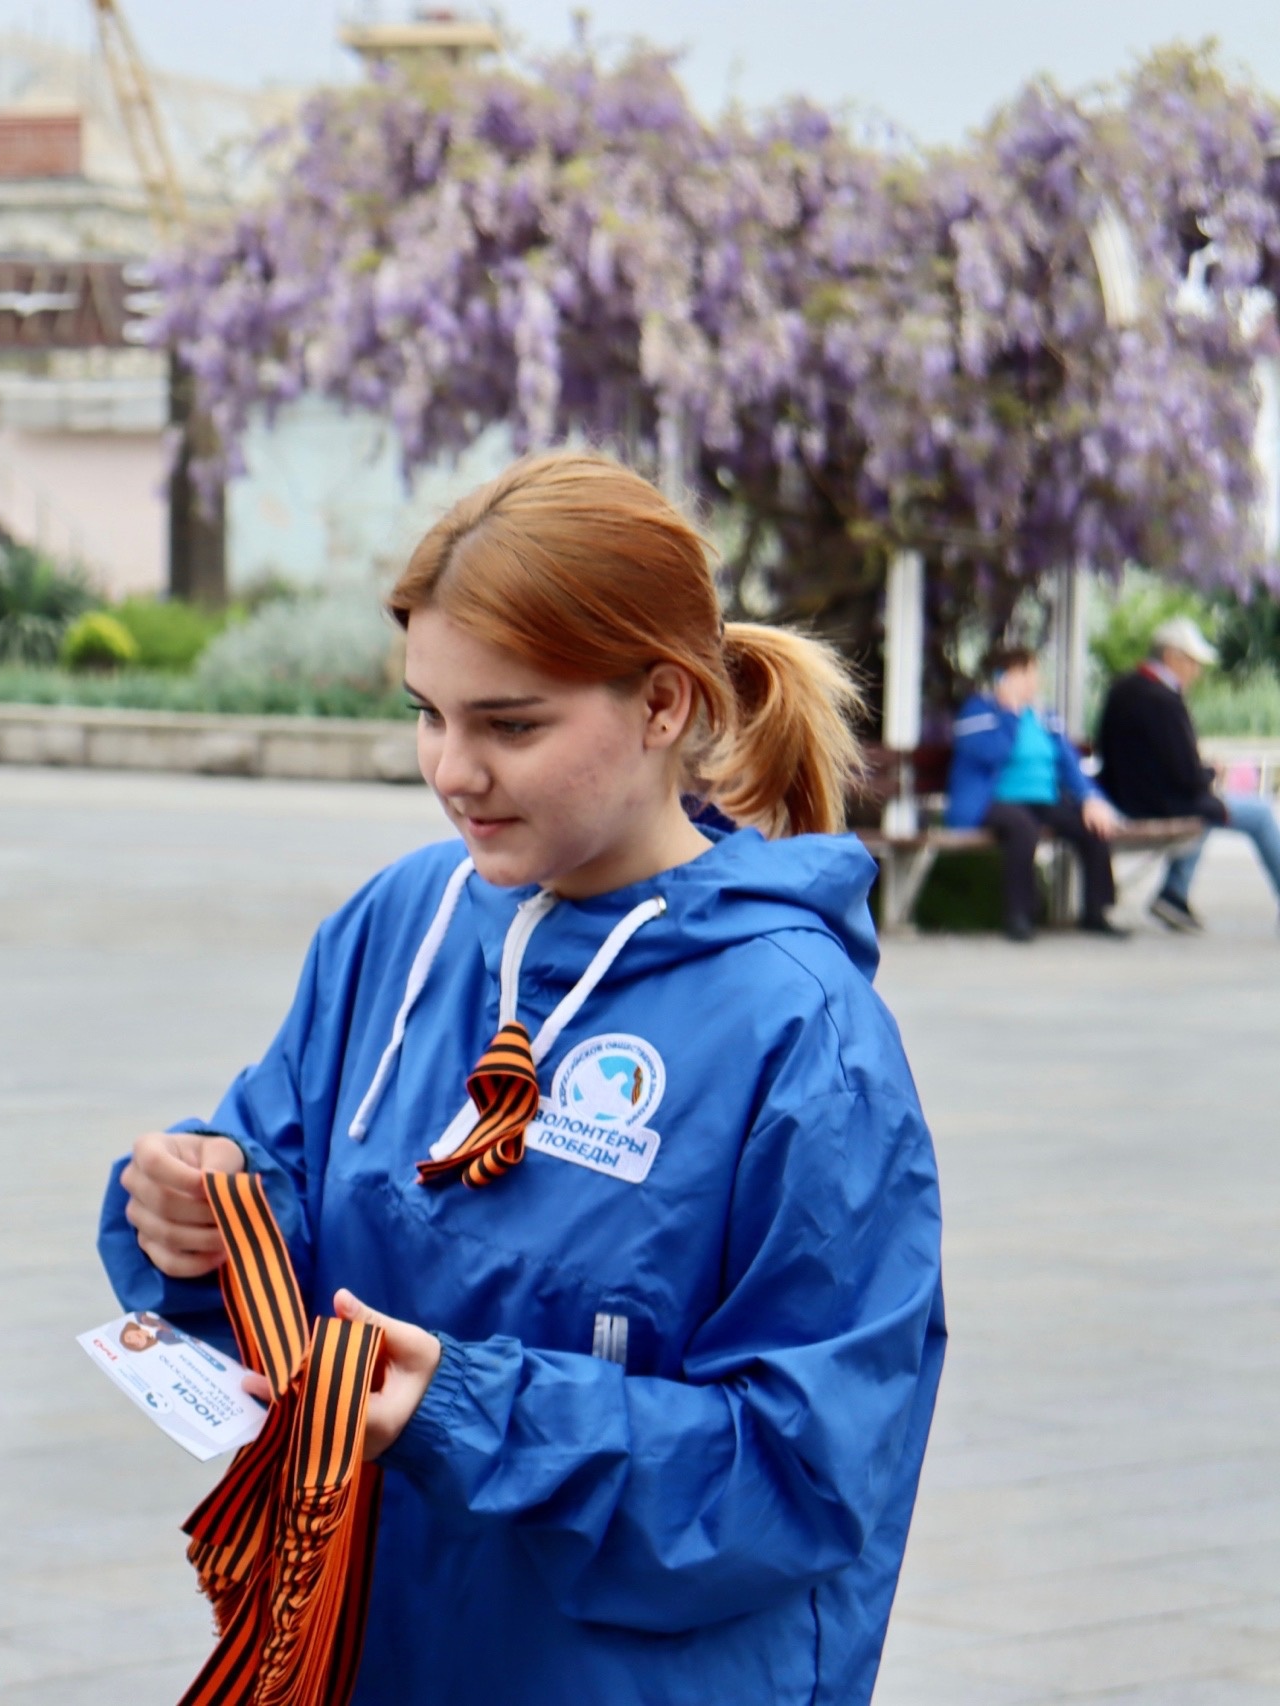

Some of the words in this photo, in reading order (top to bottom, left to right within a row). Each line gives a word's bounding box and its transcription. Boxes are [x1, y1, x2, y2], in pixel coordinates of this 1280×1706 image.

[533, 1109, 648, 1157] ВОЛОНТЁРЫ
[538, 1130, 621, 1168] ПОБЕДЫ
[169, 1381, 223, 1427] НОСИ
